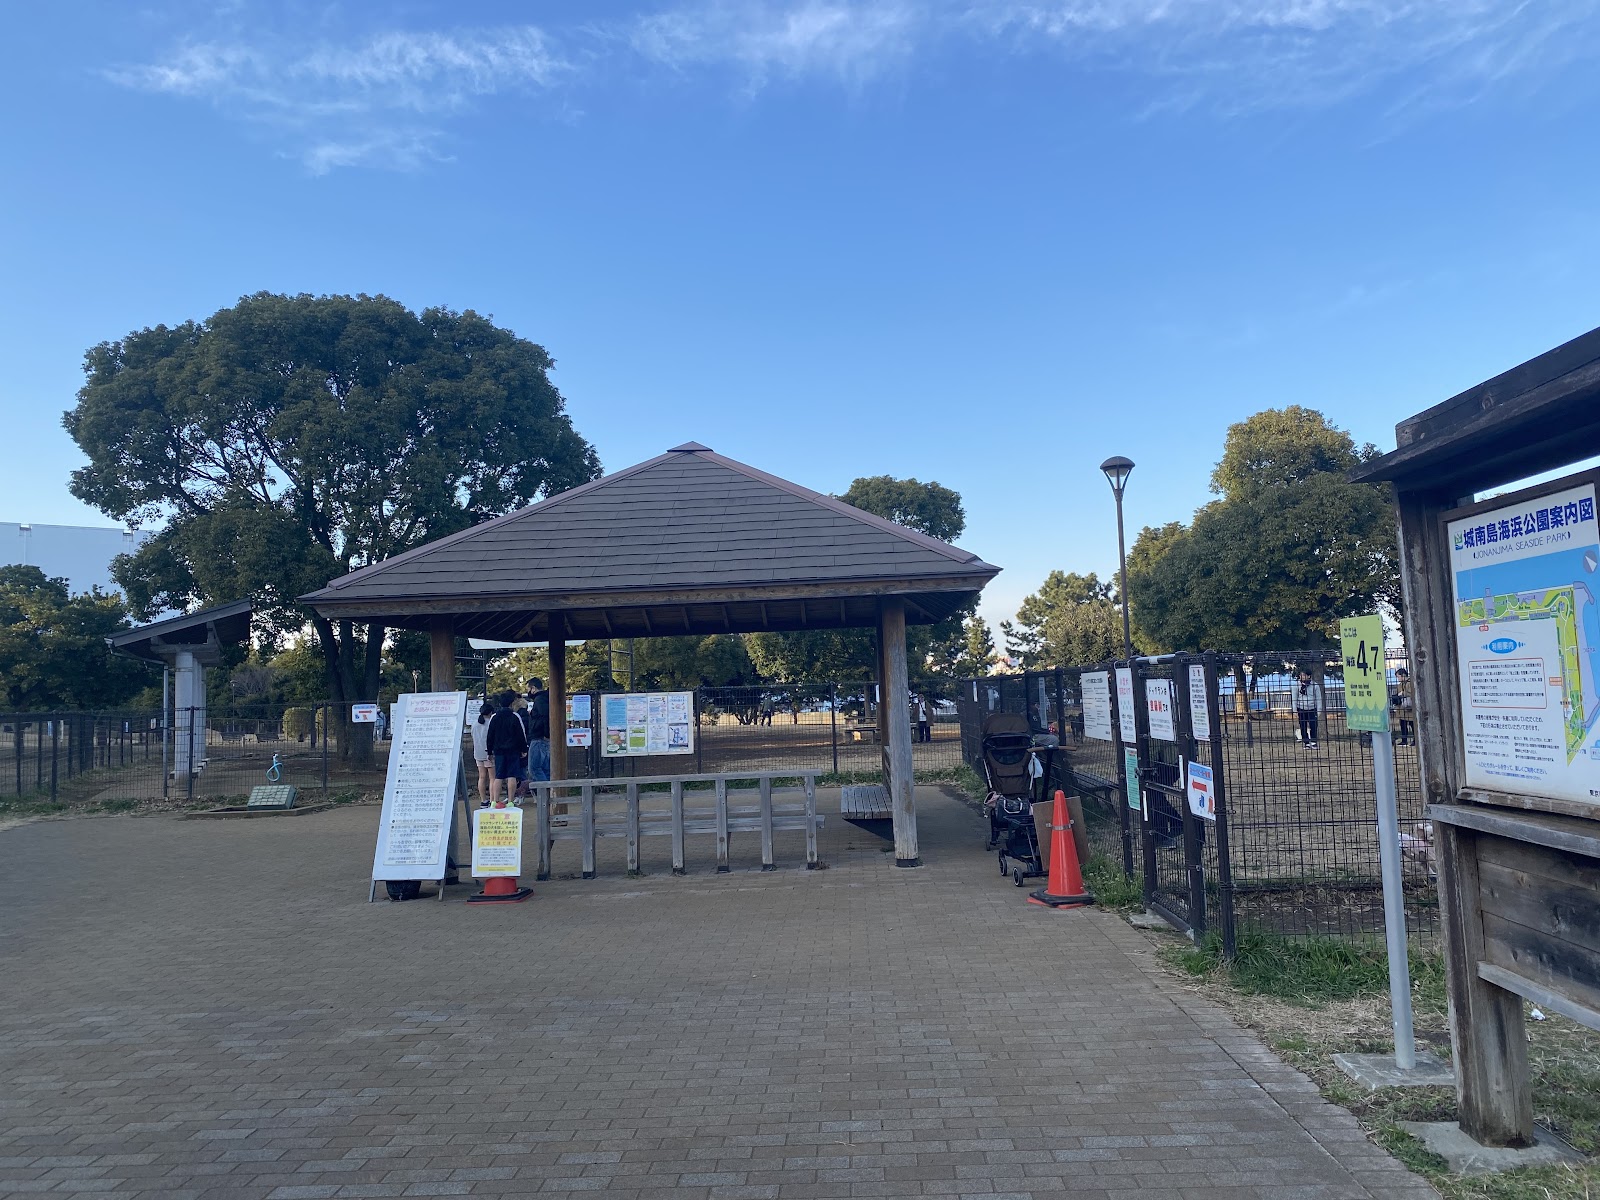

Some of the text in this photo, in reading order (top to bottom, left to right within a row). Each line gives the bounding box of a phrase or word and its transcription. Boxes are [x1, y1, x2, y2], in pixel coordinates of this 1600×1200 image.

[1463, 497, 1594, 549] 城南島海浜公園案内図
[1475, 532, 1568, 560] JONANJIMA SEASIDE PARK
[1343, 627, 1357, 638] ここは
[1356, 640, 1379, 677] 4.7
